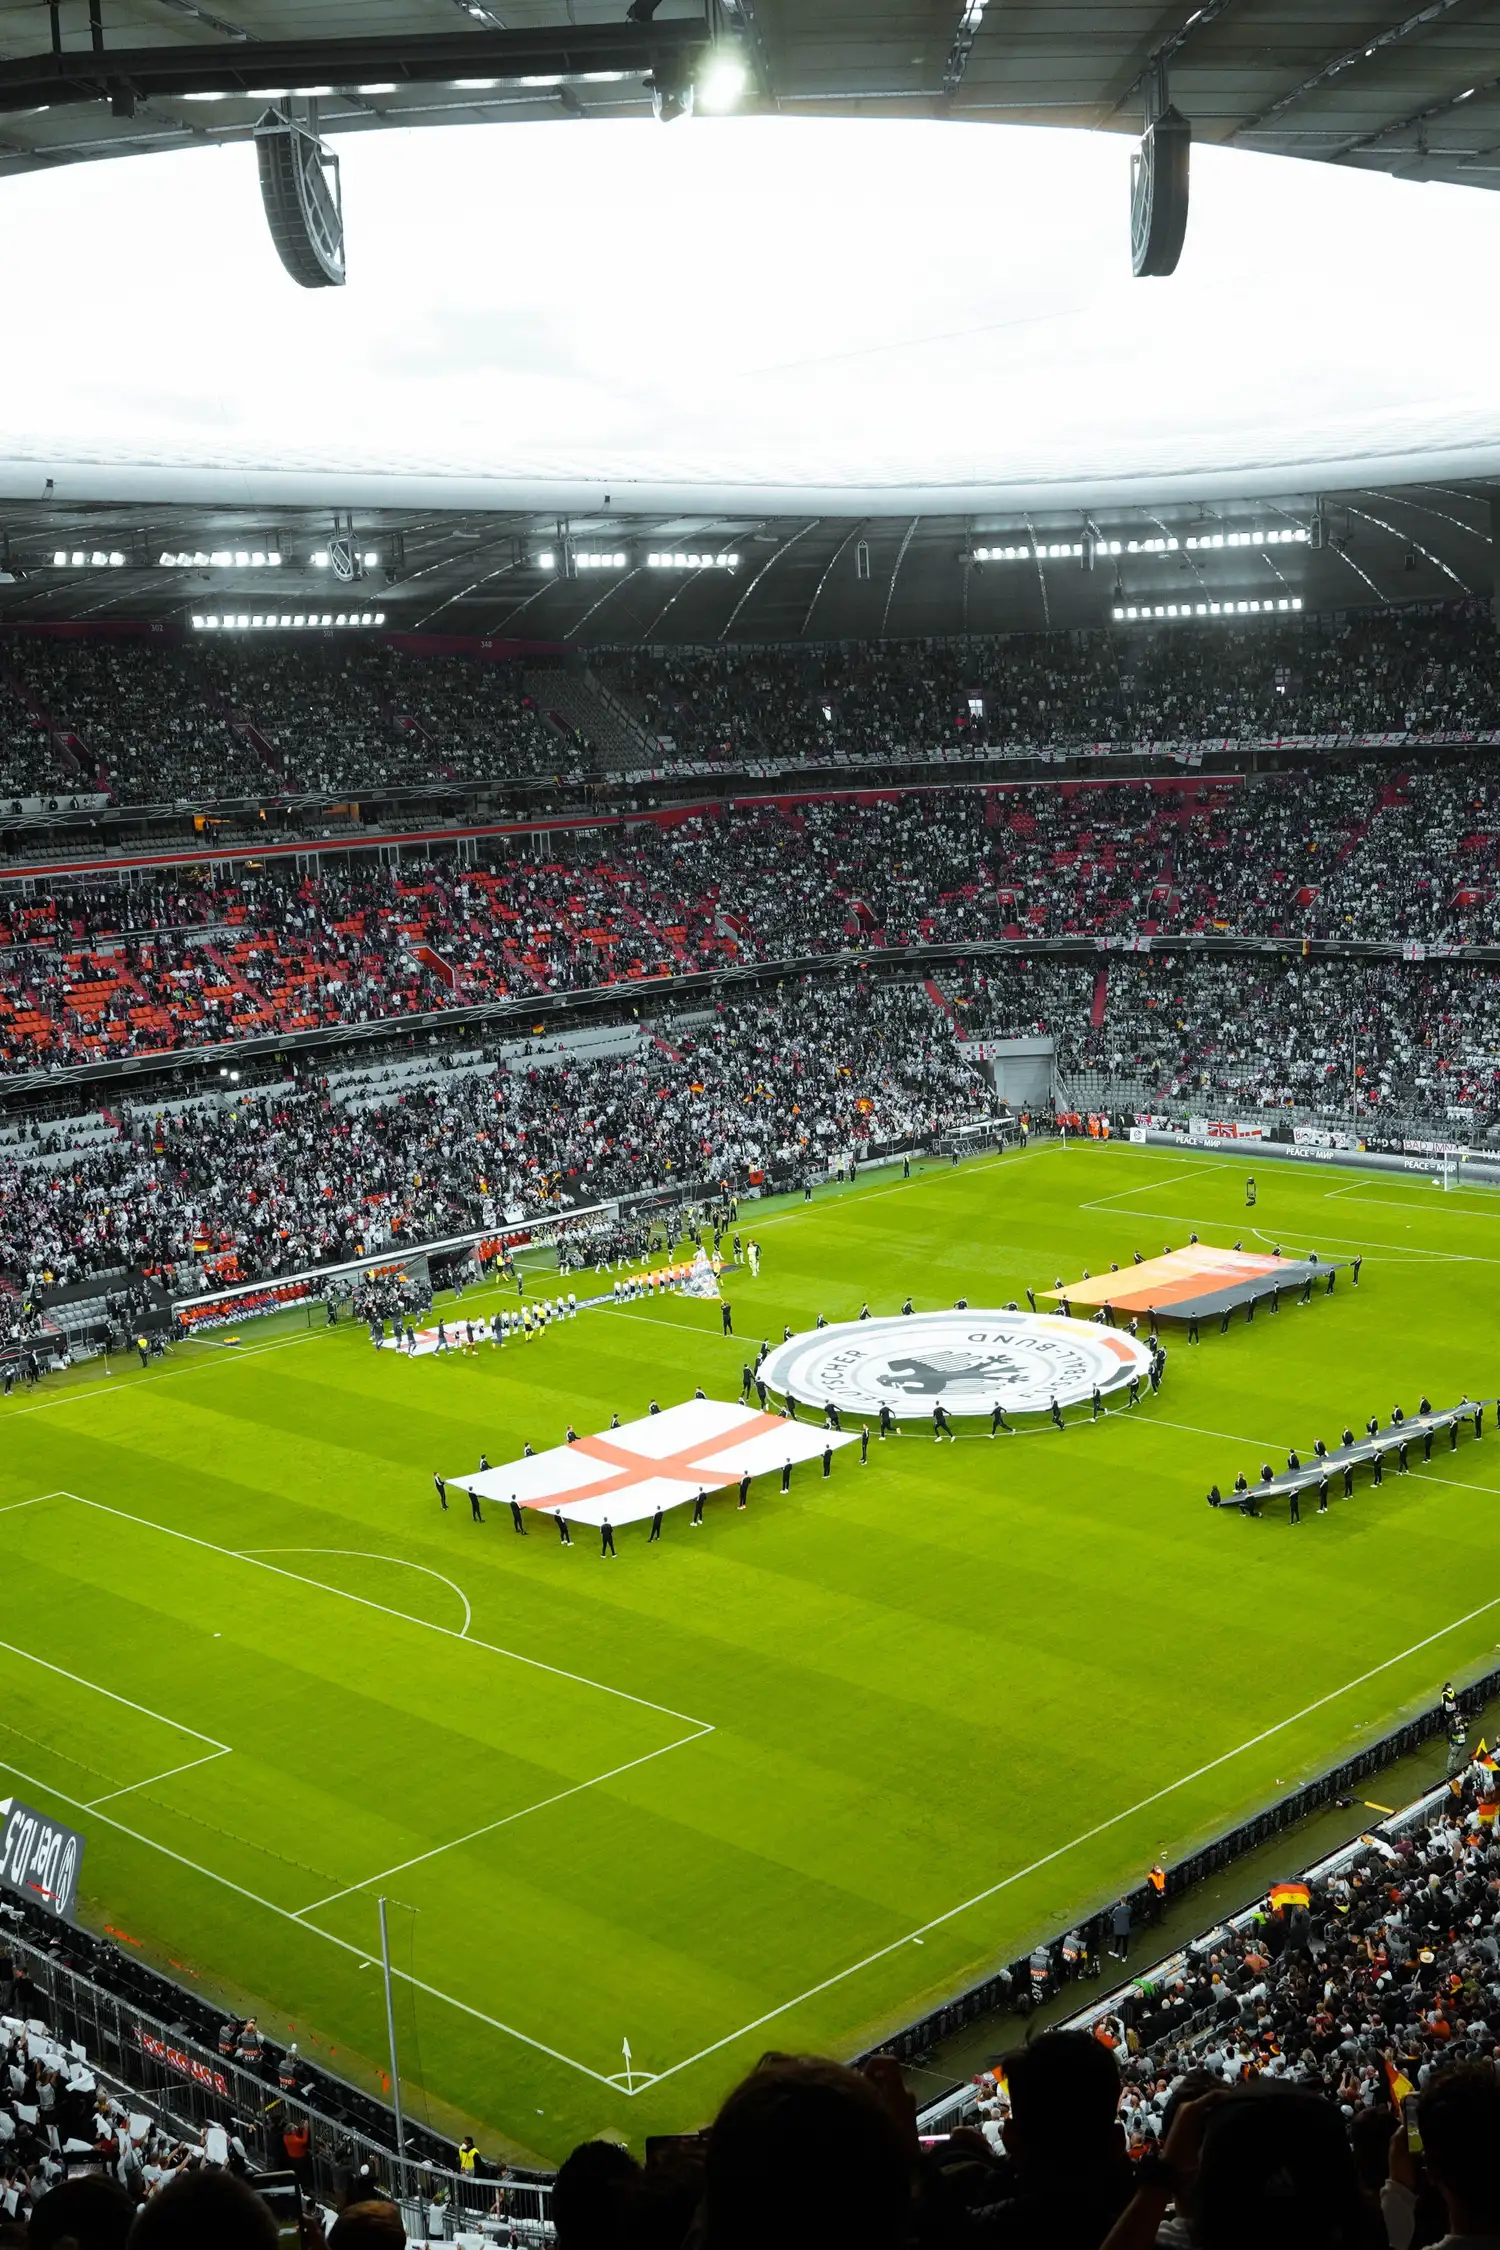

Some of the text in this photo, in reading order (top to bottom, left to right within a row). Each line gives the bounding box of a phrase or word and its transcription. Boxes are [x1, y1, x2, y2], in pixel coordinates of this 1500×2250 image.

[150, 624, 164, 632] 302
[1176, 1136, 1198, 1146] PEACE
[1404, 1140, 1428, 1150] BAD
[1286, 1147, 1310, 1157] PEACE
[1404, 1160, 1429, 1170] PEACE
[820, 1333, 1087, 1404] DEUTSCHER FUSSBALL-BUND
[30, 1826, 62, 1902] Der
